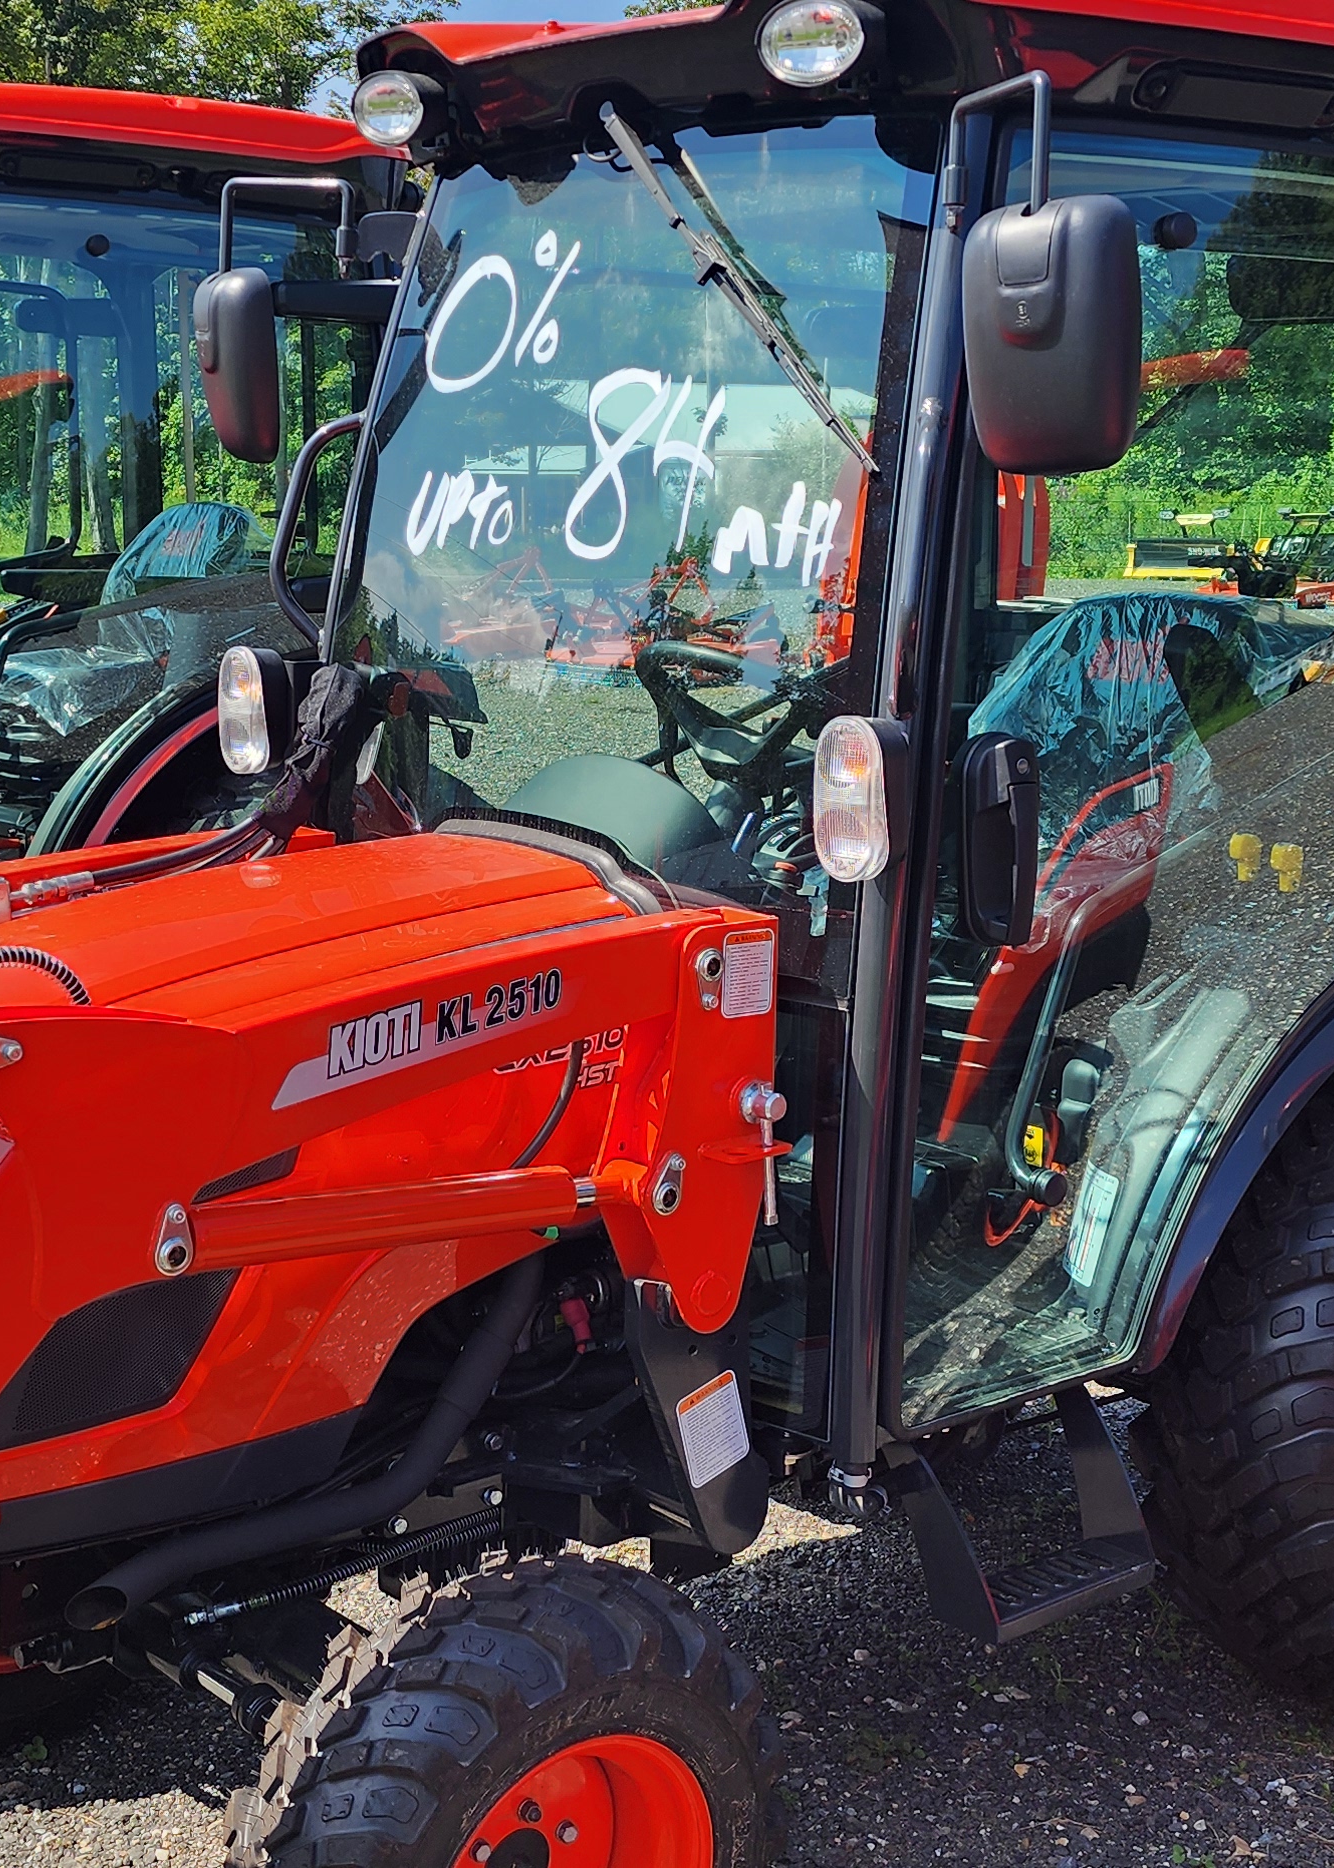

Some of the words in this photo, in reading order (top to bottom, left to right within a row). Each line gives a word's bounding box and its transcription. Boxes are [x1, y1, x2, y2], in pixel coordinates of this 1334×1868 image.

[425, 229, 581, 394] 0%
[566, 367, 726, 559] 84
[327, 999, 423, 1079] KIOTI
[435, 993, 479, 1045] KL
[483, 967, 563, 1031] 2510
